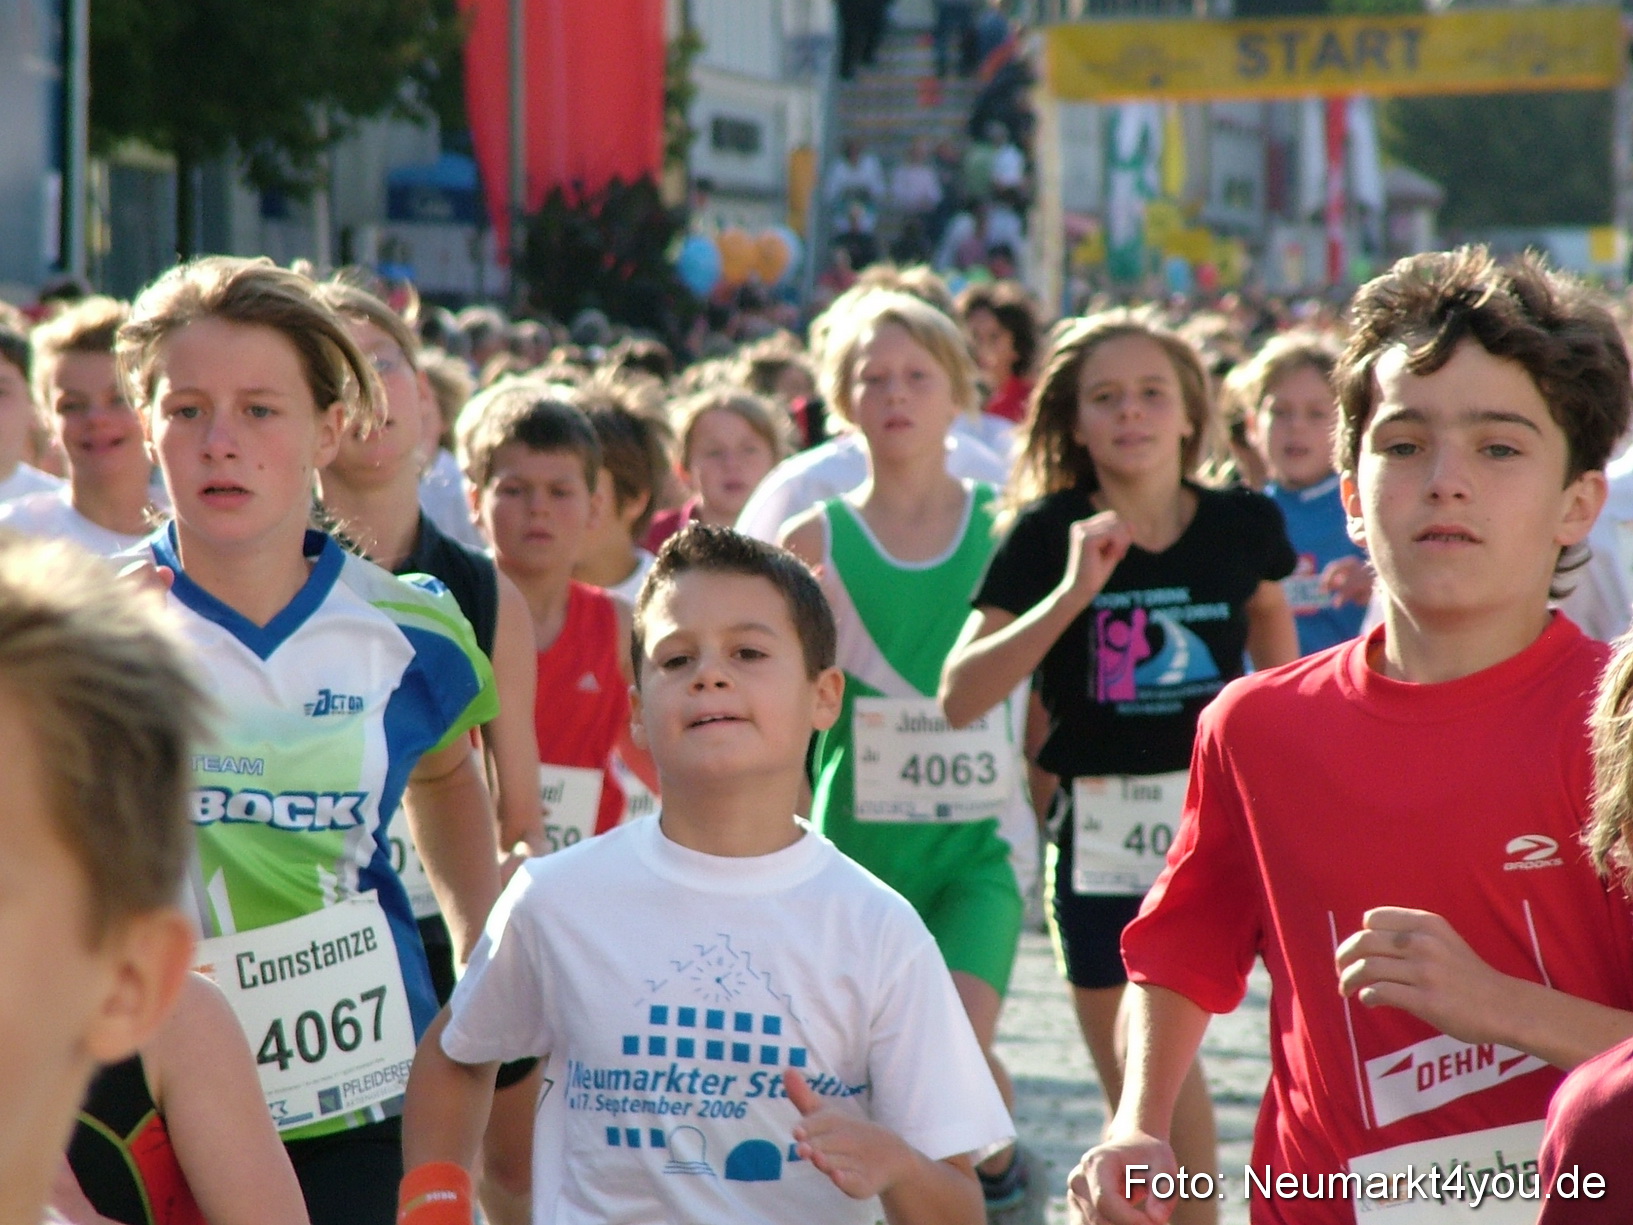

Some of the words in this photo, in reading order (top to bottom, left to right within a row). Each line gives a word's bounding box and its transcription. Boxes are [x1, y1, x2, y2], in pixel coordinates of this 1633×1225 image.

[1237, 26, 1425, 80] START
[192, 754, 265, 776] TEAM
[901, 752, 996, 786] 4063
[189, 784, 370, 832] BOCK
[1123, 823, 1172, 857] 40
[1503, 858, 1564, 871] BROOKS
[236, 926, 379, 989] Constanze
[256, 985, 387, 1071] 4067
[572, 1061, 737, 1097] Neumarkter
[1417, 1044, 1496, 1092] DEHN
[595, 1094, 692, 1117] September
[697, 1099, 748, 1119] 2006
